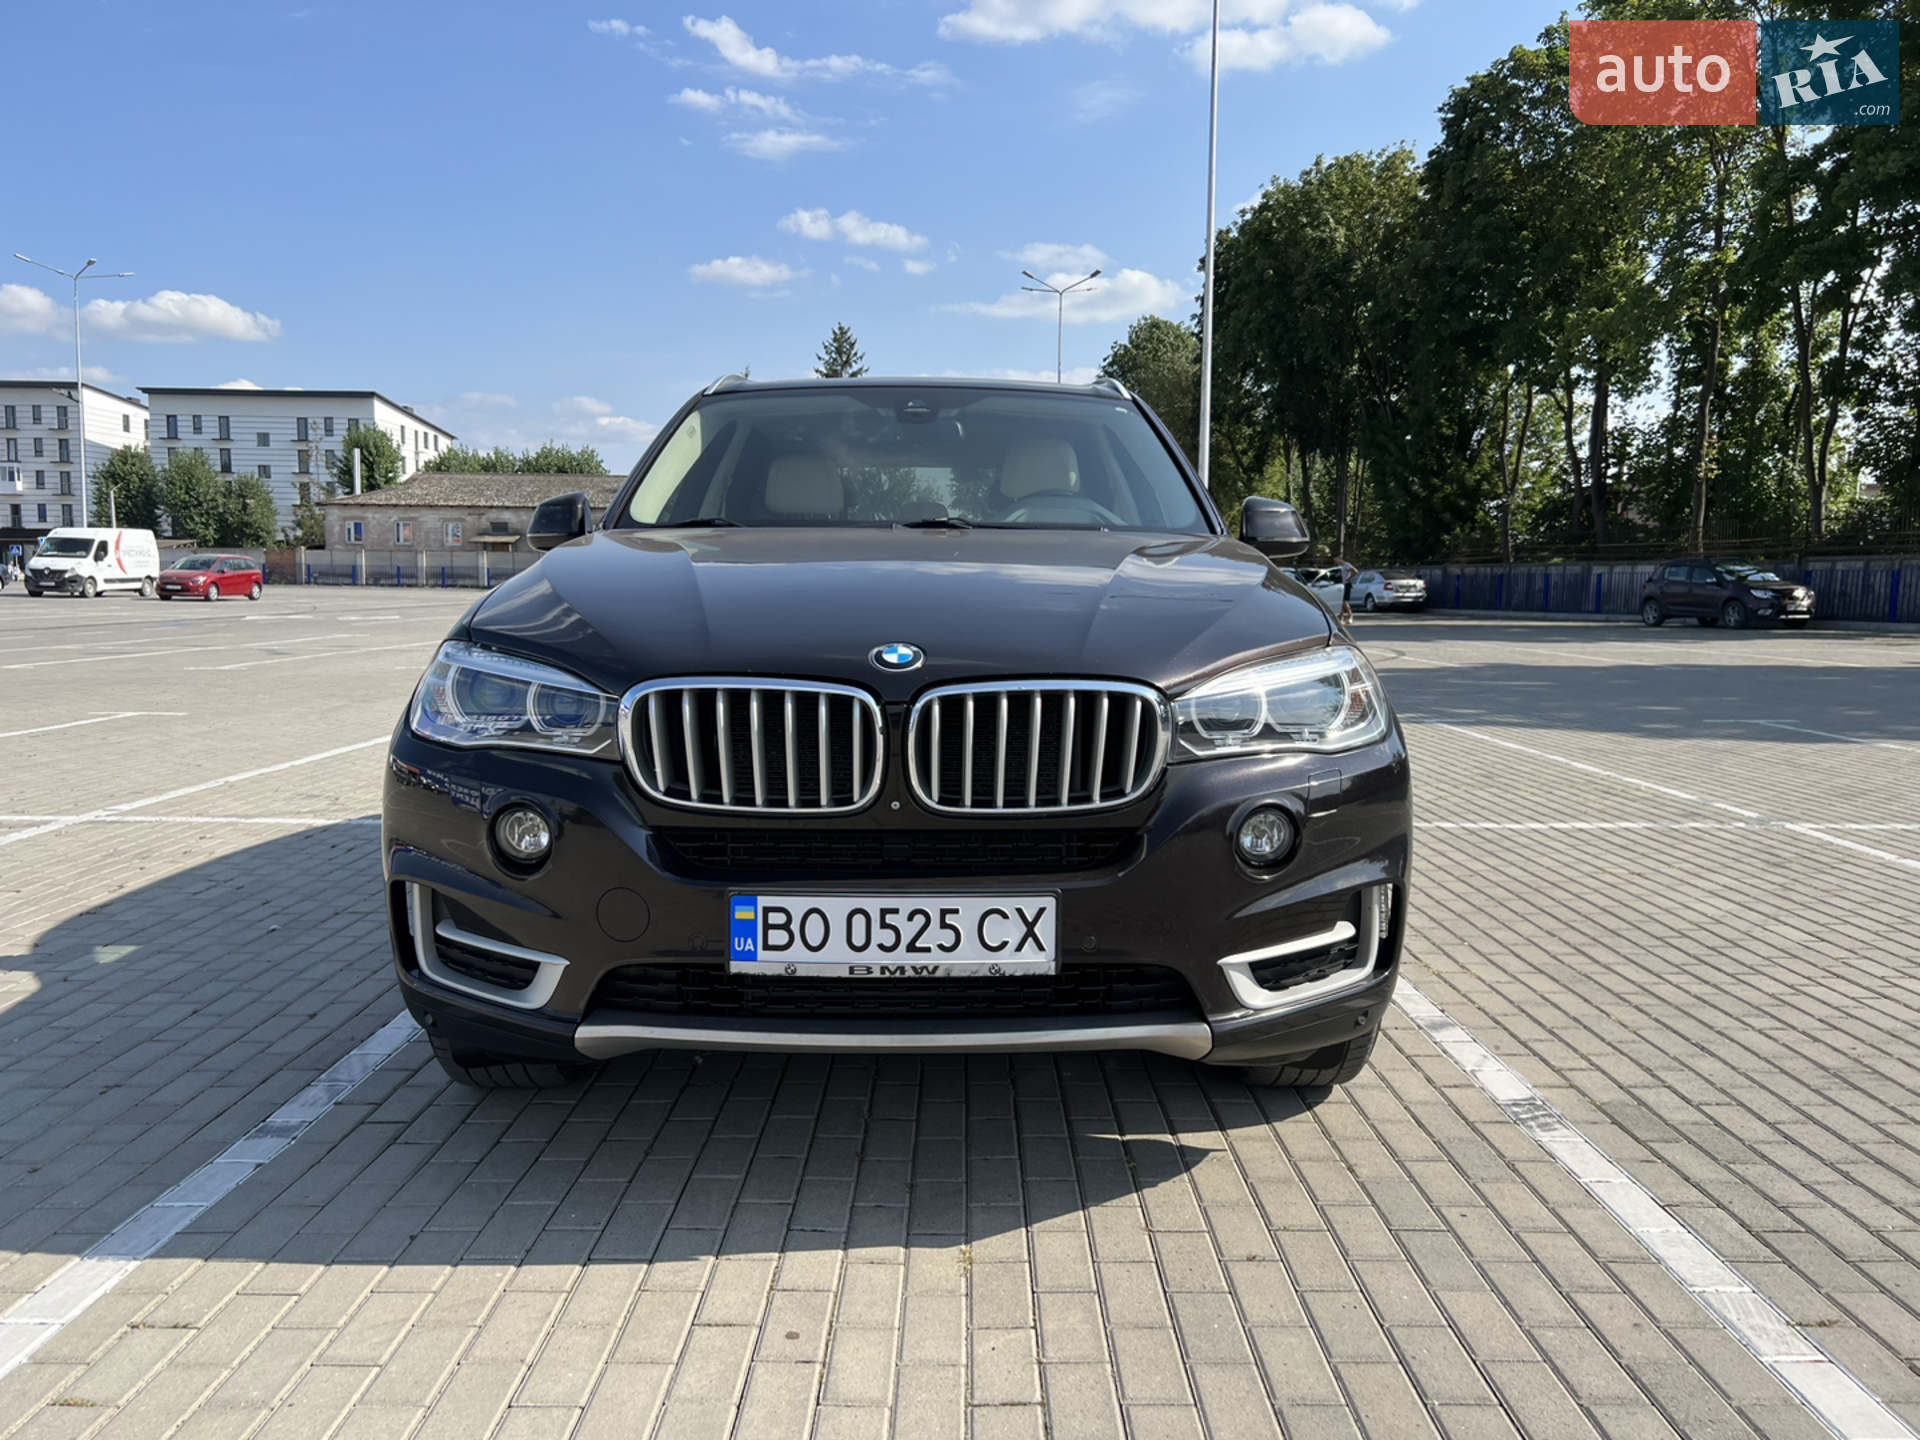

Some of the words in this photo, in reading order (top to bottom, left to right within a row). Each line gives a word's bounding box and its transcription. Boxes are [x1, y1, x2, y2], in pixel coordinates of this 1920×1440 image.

[761, 905, 831, 953] BO
[845, 906, 963, 953] 0525
[976, 906, 1048, 953] CX
[734, 936, 755, 952] UA
[848, 965, 940, 976] BMW
